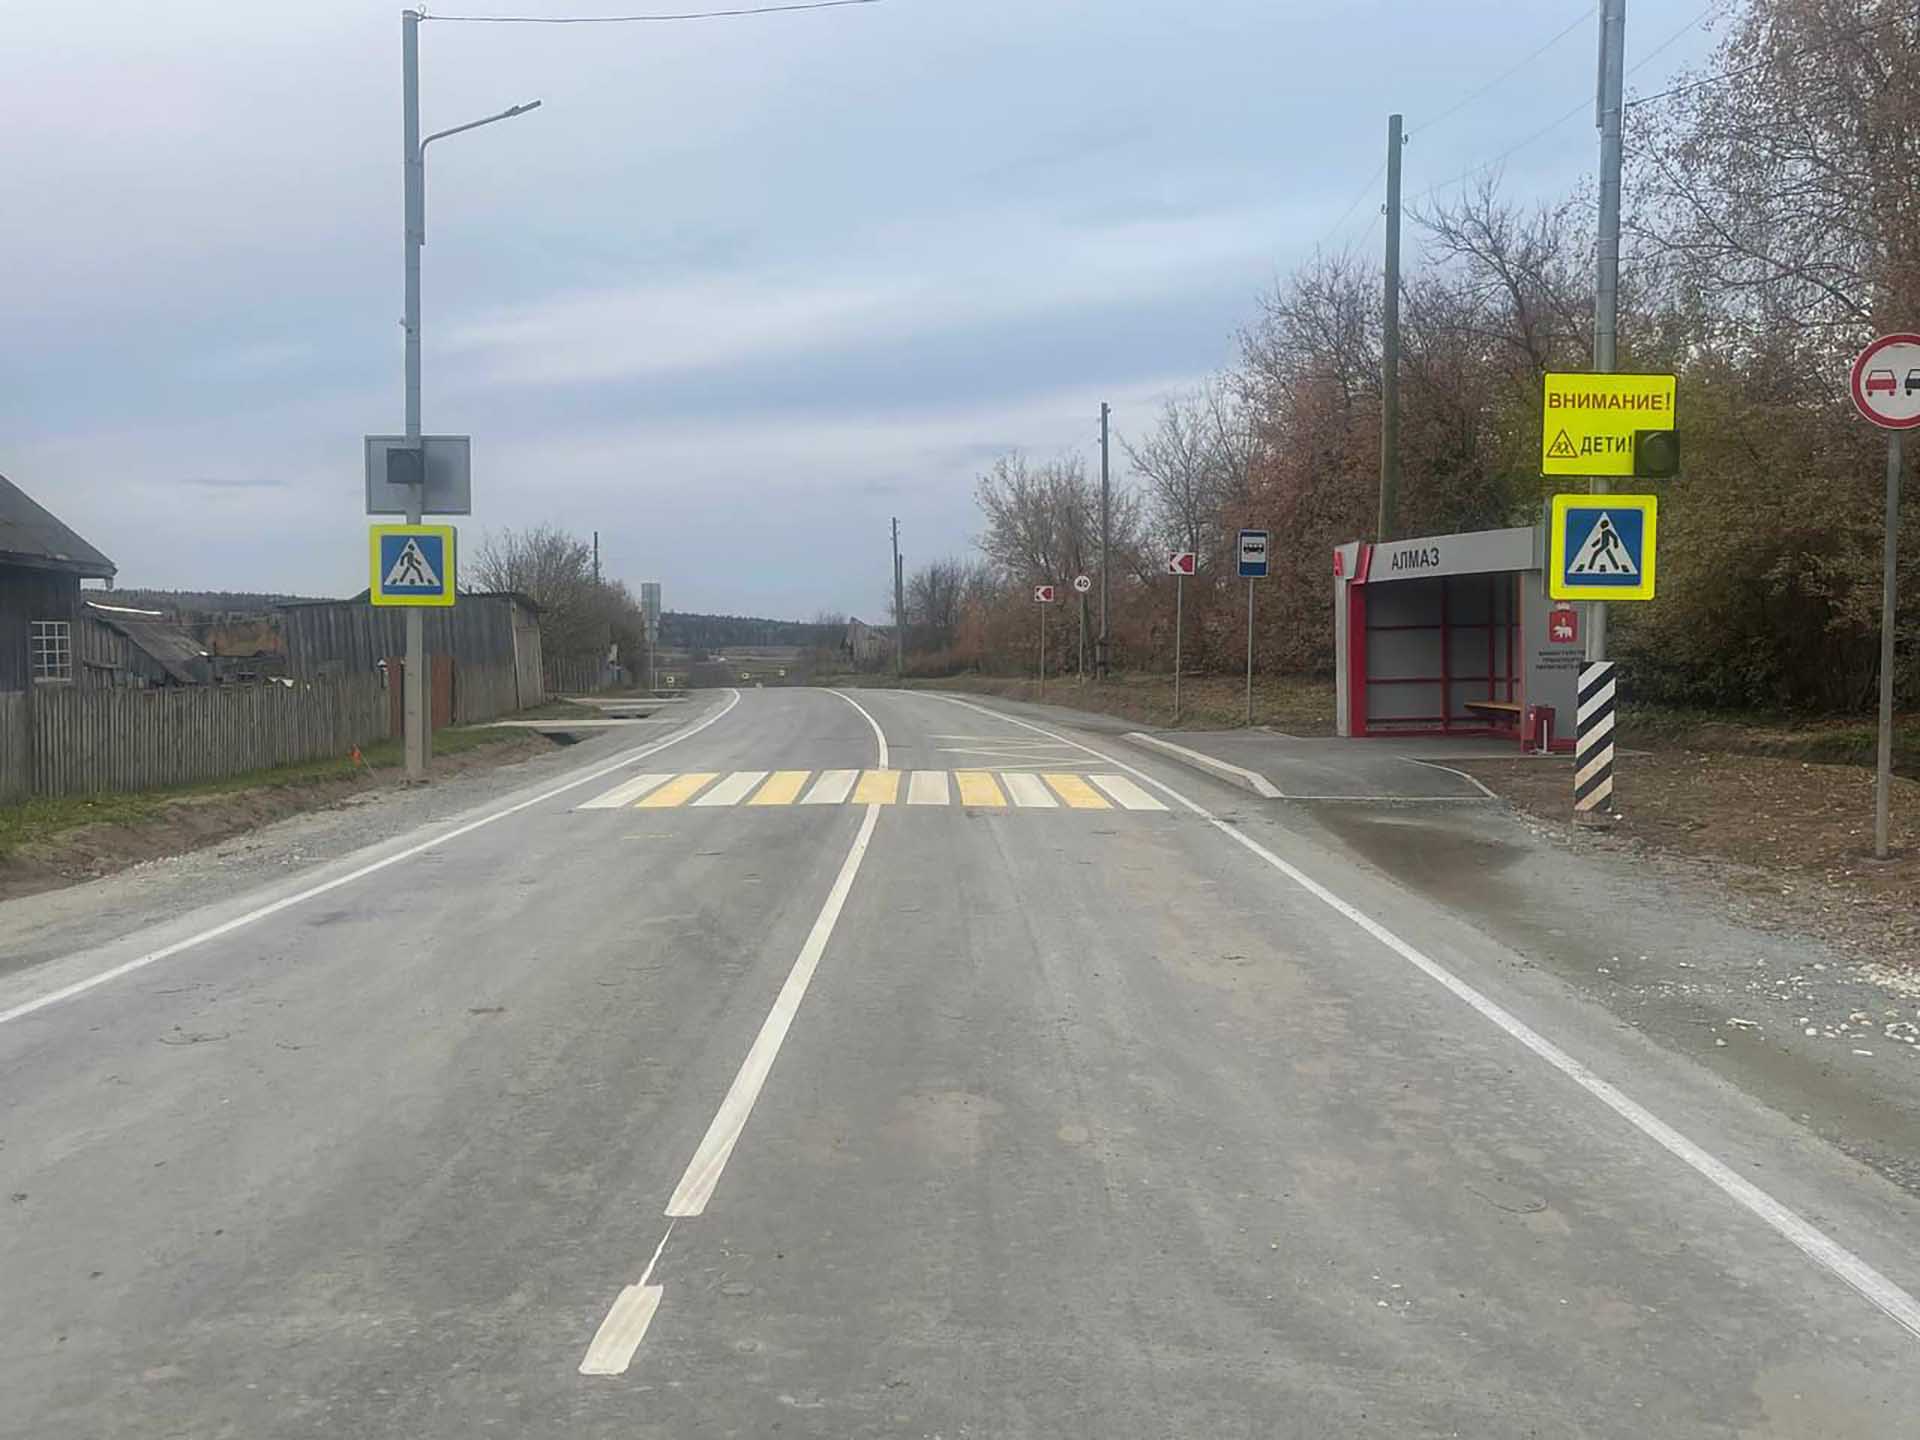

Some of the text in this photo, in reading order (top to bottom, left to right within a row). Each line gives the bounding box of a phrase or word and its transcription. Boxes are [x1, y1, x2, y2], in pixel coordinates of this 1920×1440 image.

[1549, 392, 1671, 411] ВНИМАНИЕ!
[1580, 435, 1633, 456] ДЕТИ!
[1392, 547, 1440, 571] АЛМАЗ
